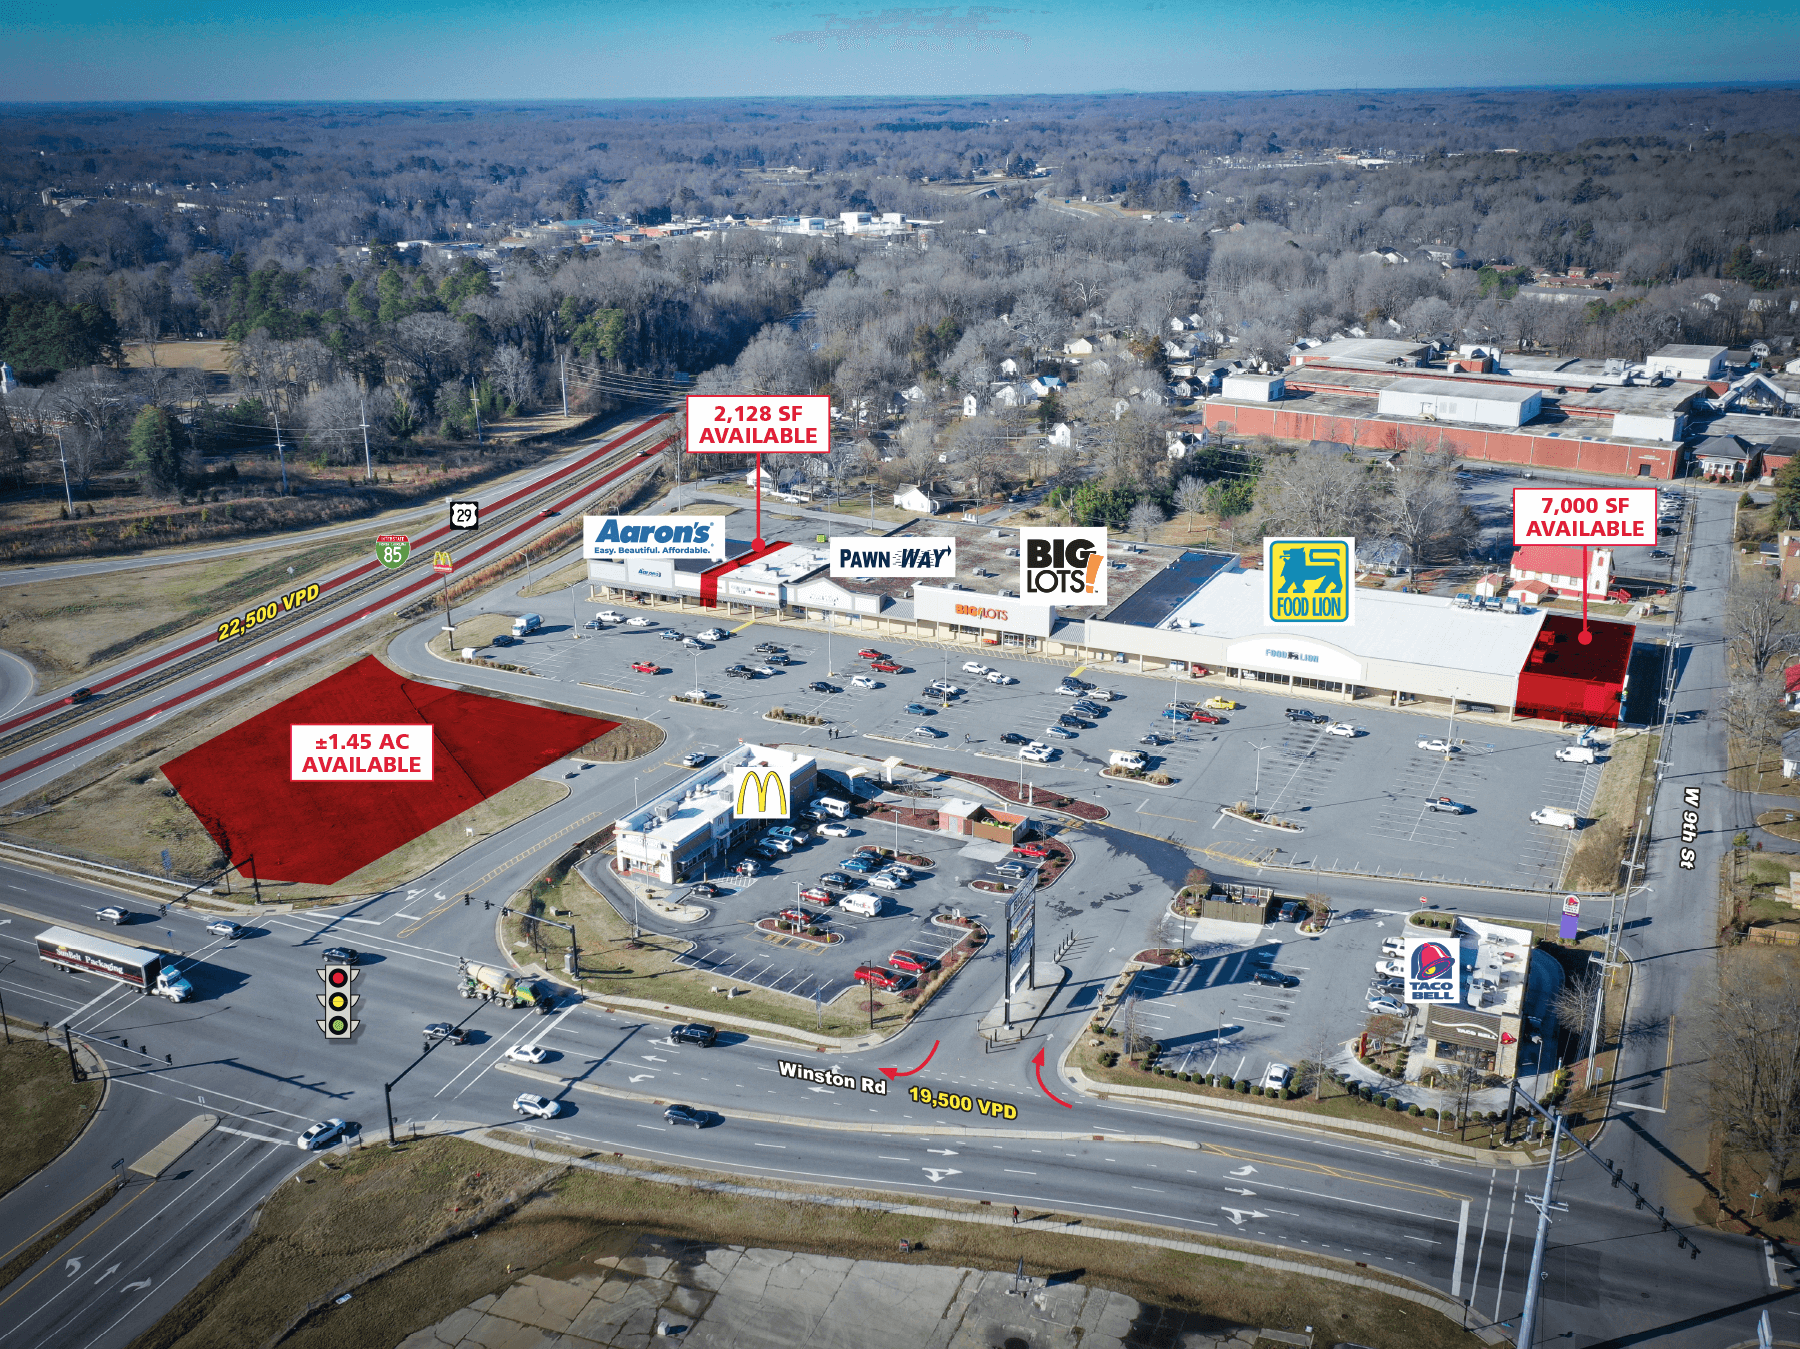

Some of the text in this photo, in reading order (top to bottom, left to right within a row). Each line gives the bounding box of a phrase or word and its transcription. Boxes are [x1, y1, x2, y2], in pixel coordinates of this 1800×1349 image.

[1265, 648, 1319, 663] FOOD LION
[84, 955, 123, 975] Packaging
